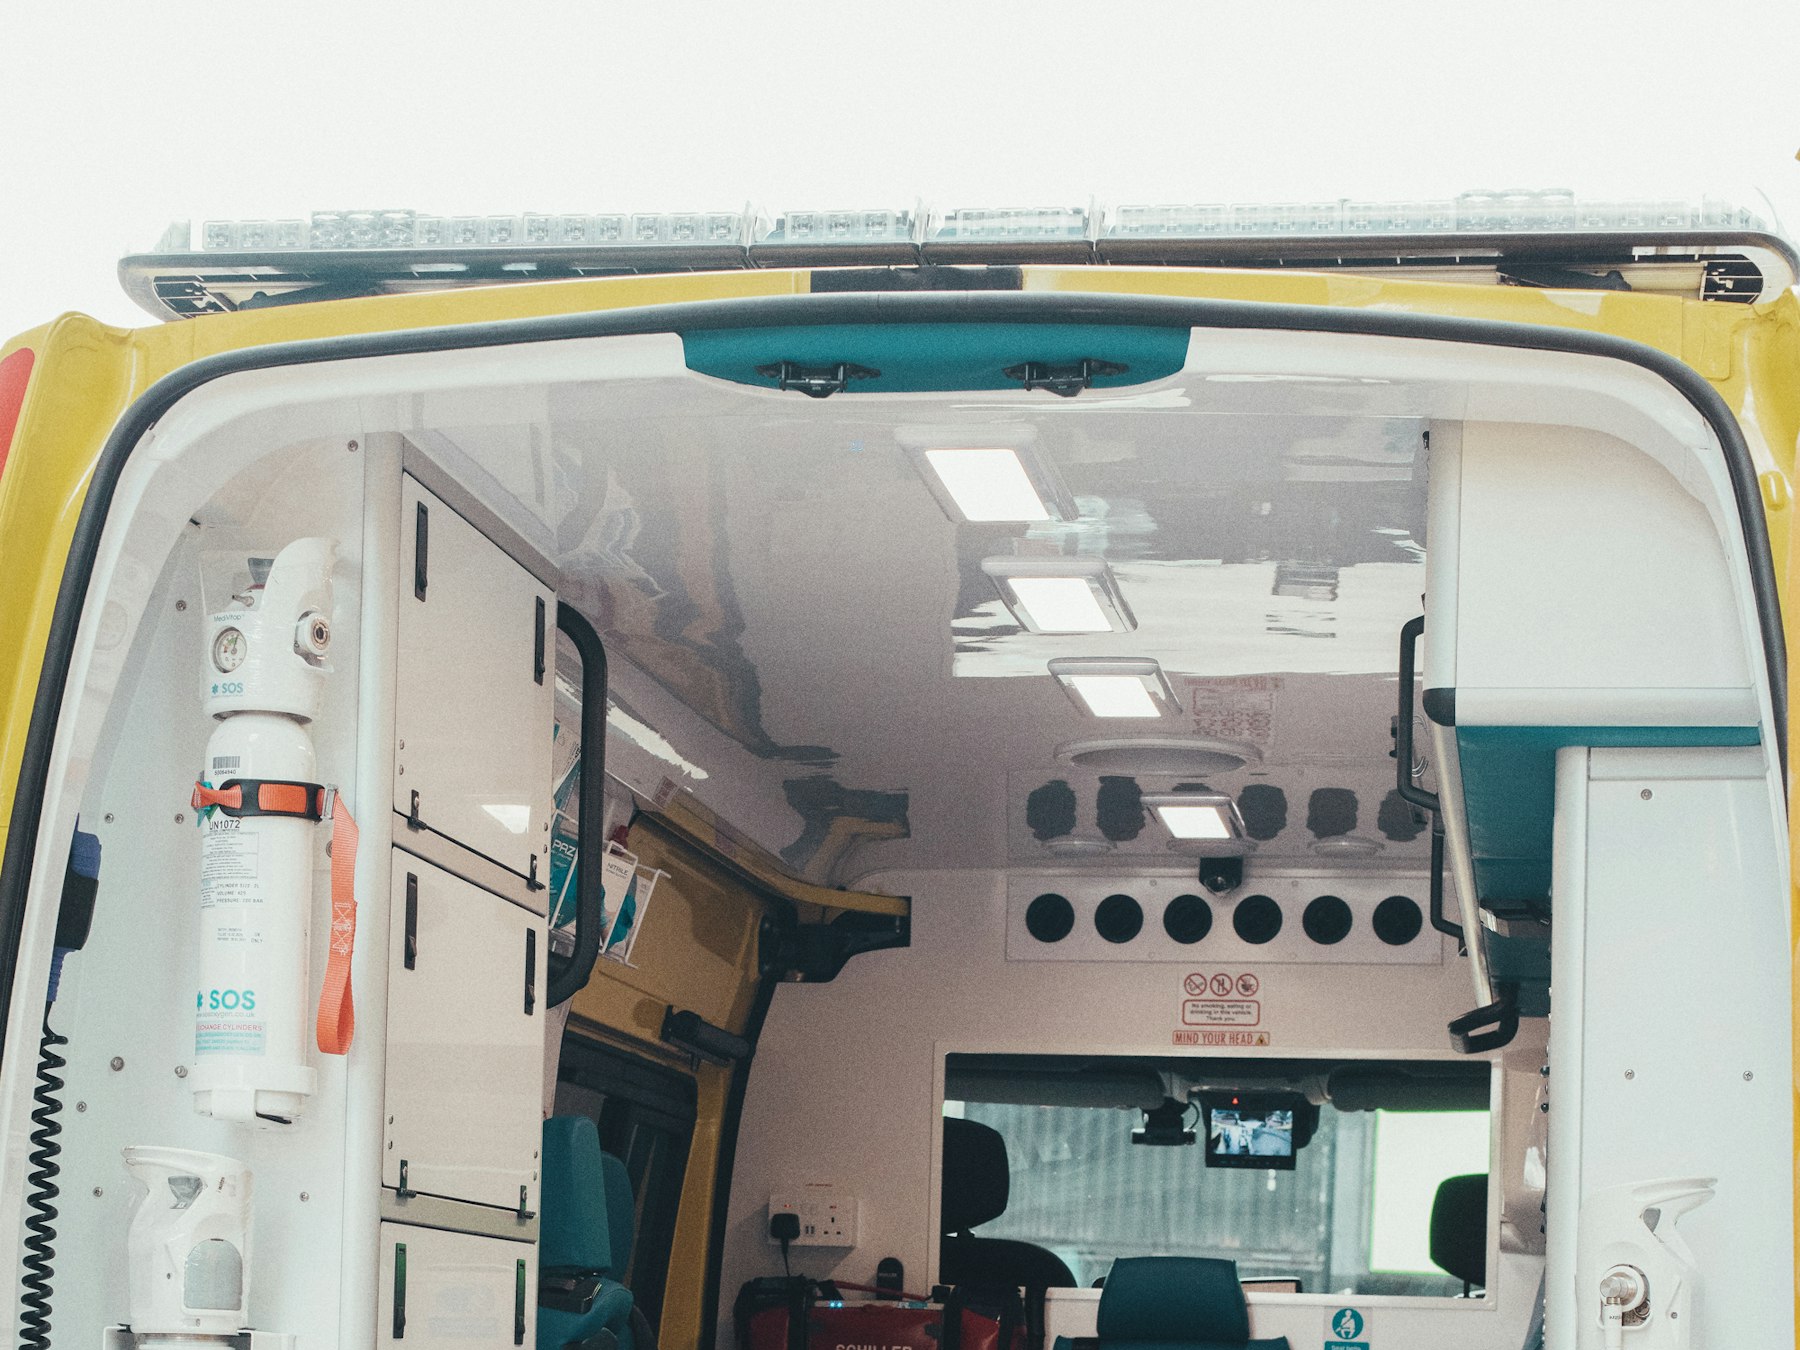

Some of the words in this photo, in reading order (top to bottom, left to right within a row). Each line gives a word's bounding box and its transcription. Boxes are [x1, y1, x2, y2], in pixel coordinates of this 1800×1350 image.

[221, 682, 244, 694] SOS
[608, 862, 629, 876] NITRILE
[209, 989, 256, 1011] SOS
[222, 1024, 263, 1032] CYLINDERS
[1175, 1032, 1199, 1044] MIND
[1202, 1032, 1226, 1044] YOUR
[1229, 1033, 1253, 1045] HEAD
